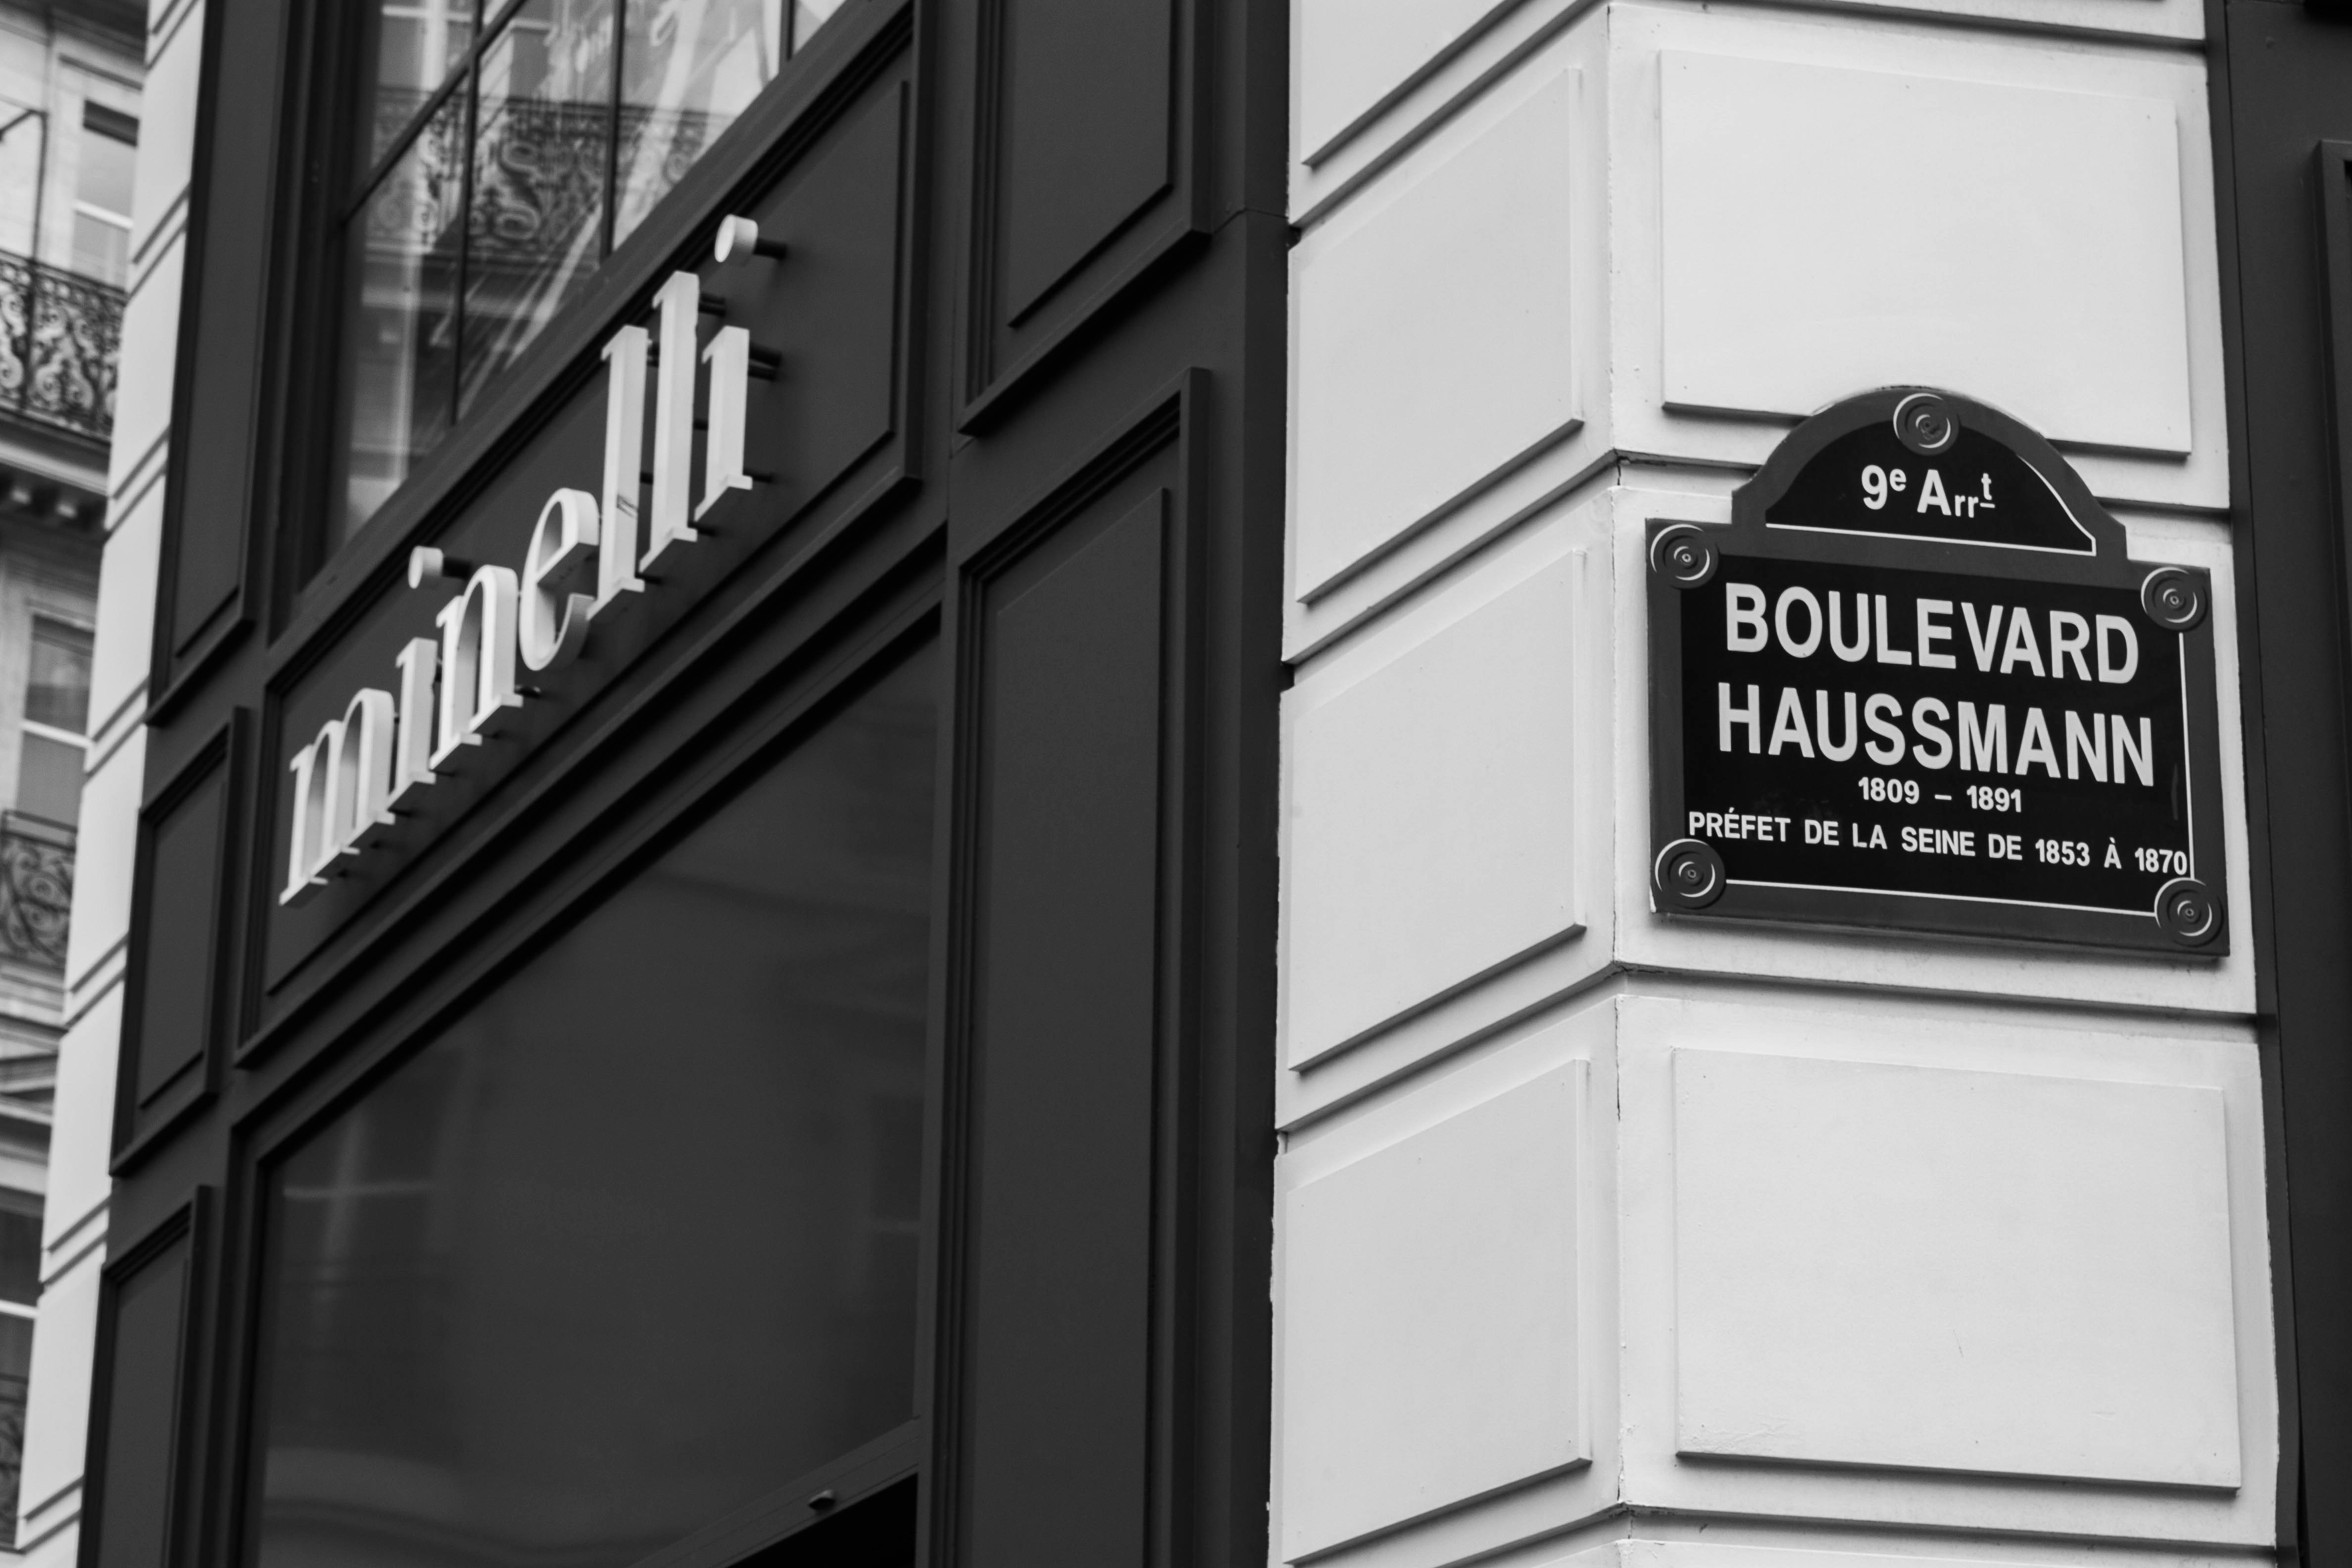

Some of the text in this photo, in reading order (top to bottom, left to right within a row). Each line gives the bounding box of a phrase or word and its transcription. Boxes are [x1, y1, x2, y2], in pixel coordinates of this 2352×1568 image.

[279, 214, 758, 905] minelli
[1726, 582, 2139, 684] BOULEVARD
[1718, 682, 2154, 786] HAUSSMANN
[1689, 807, 2188, 876] PRÉFET DE LA SEINE DE 1853 À 1870
[1858, 777, 1919, 804] 1809
[1966, 785, 2021, 813] 1891
